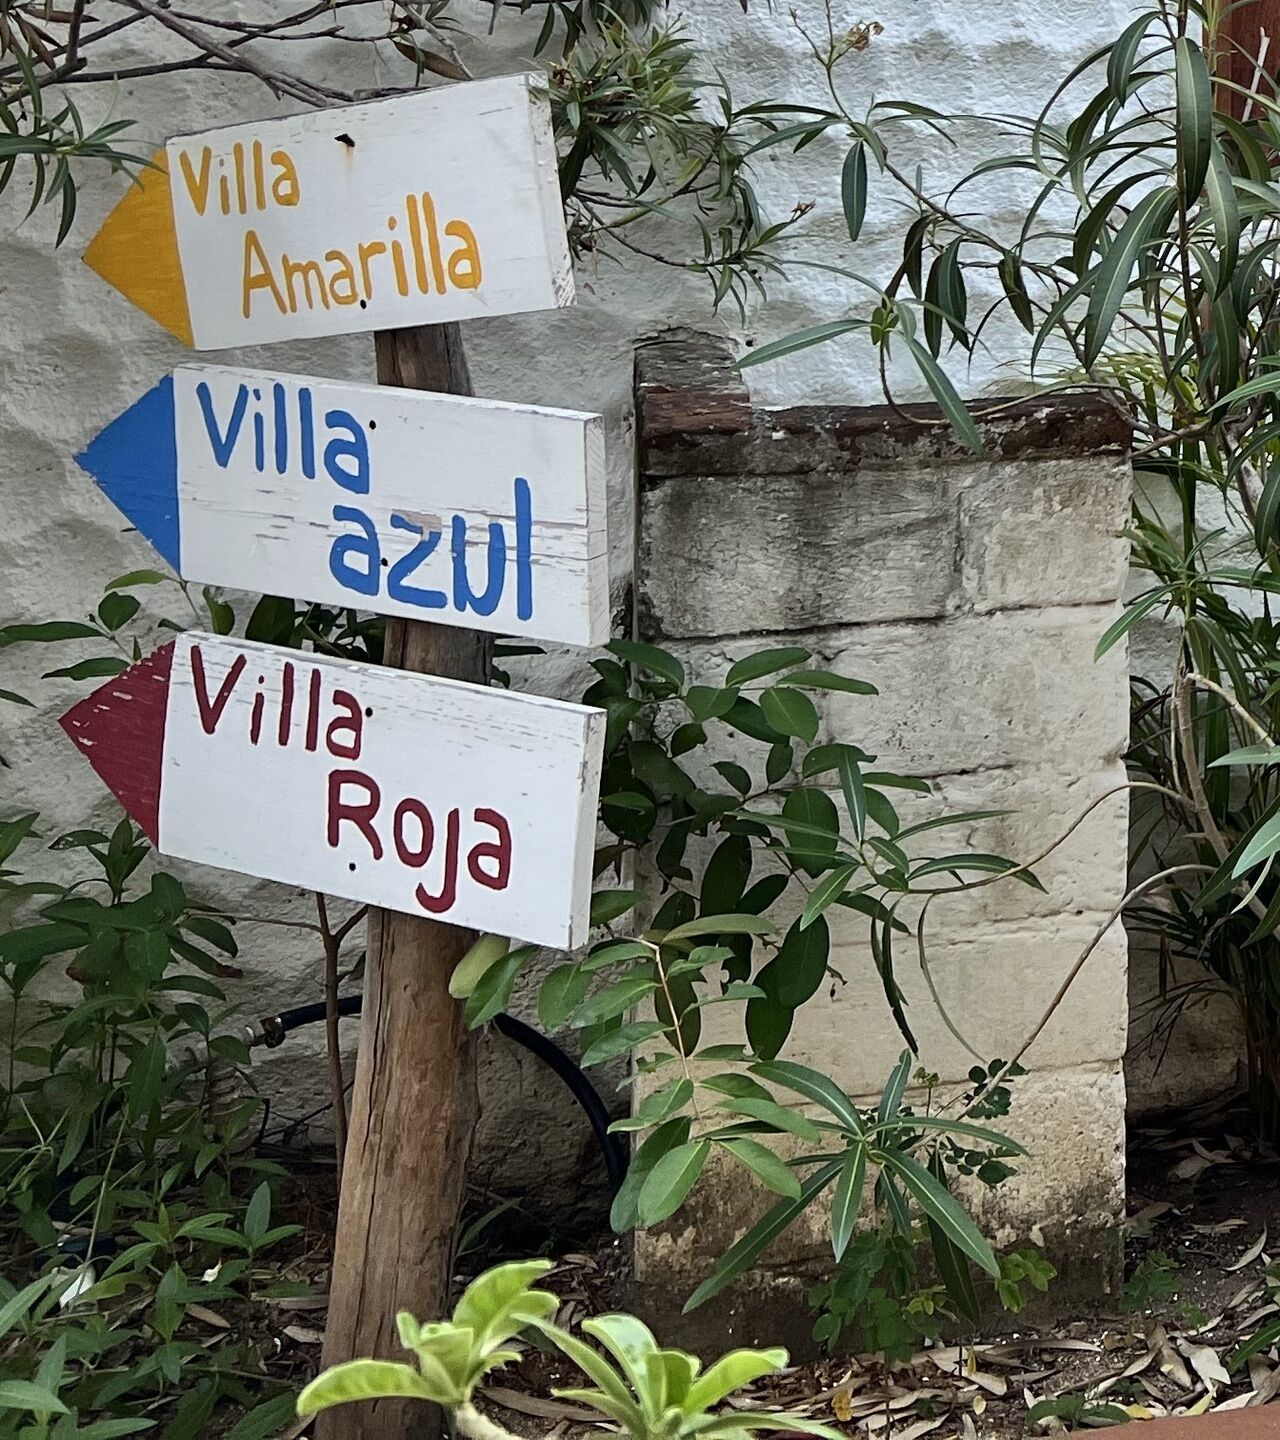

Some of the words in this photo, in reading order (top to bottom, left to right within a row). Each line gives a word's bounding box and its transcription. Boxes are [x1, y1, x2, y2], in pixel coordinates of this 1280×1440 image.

[180, 141, 300, 215] Villa
[242, 193, 482, 318] Amarilla
[197, 382, 370, 494] Villa
[329, 478, 532, 621] azul
[190, 644, 363, 759] Villa
[327, 769, 512, 913] Roja
